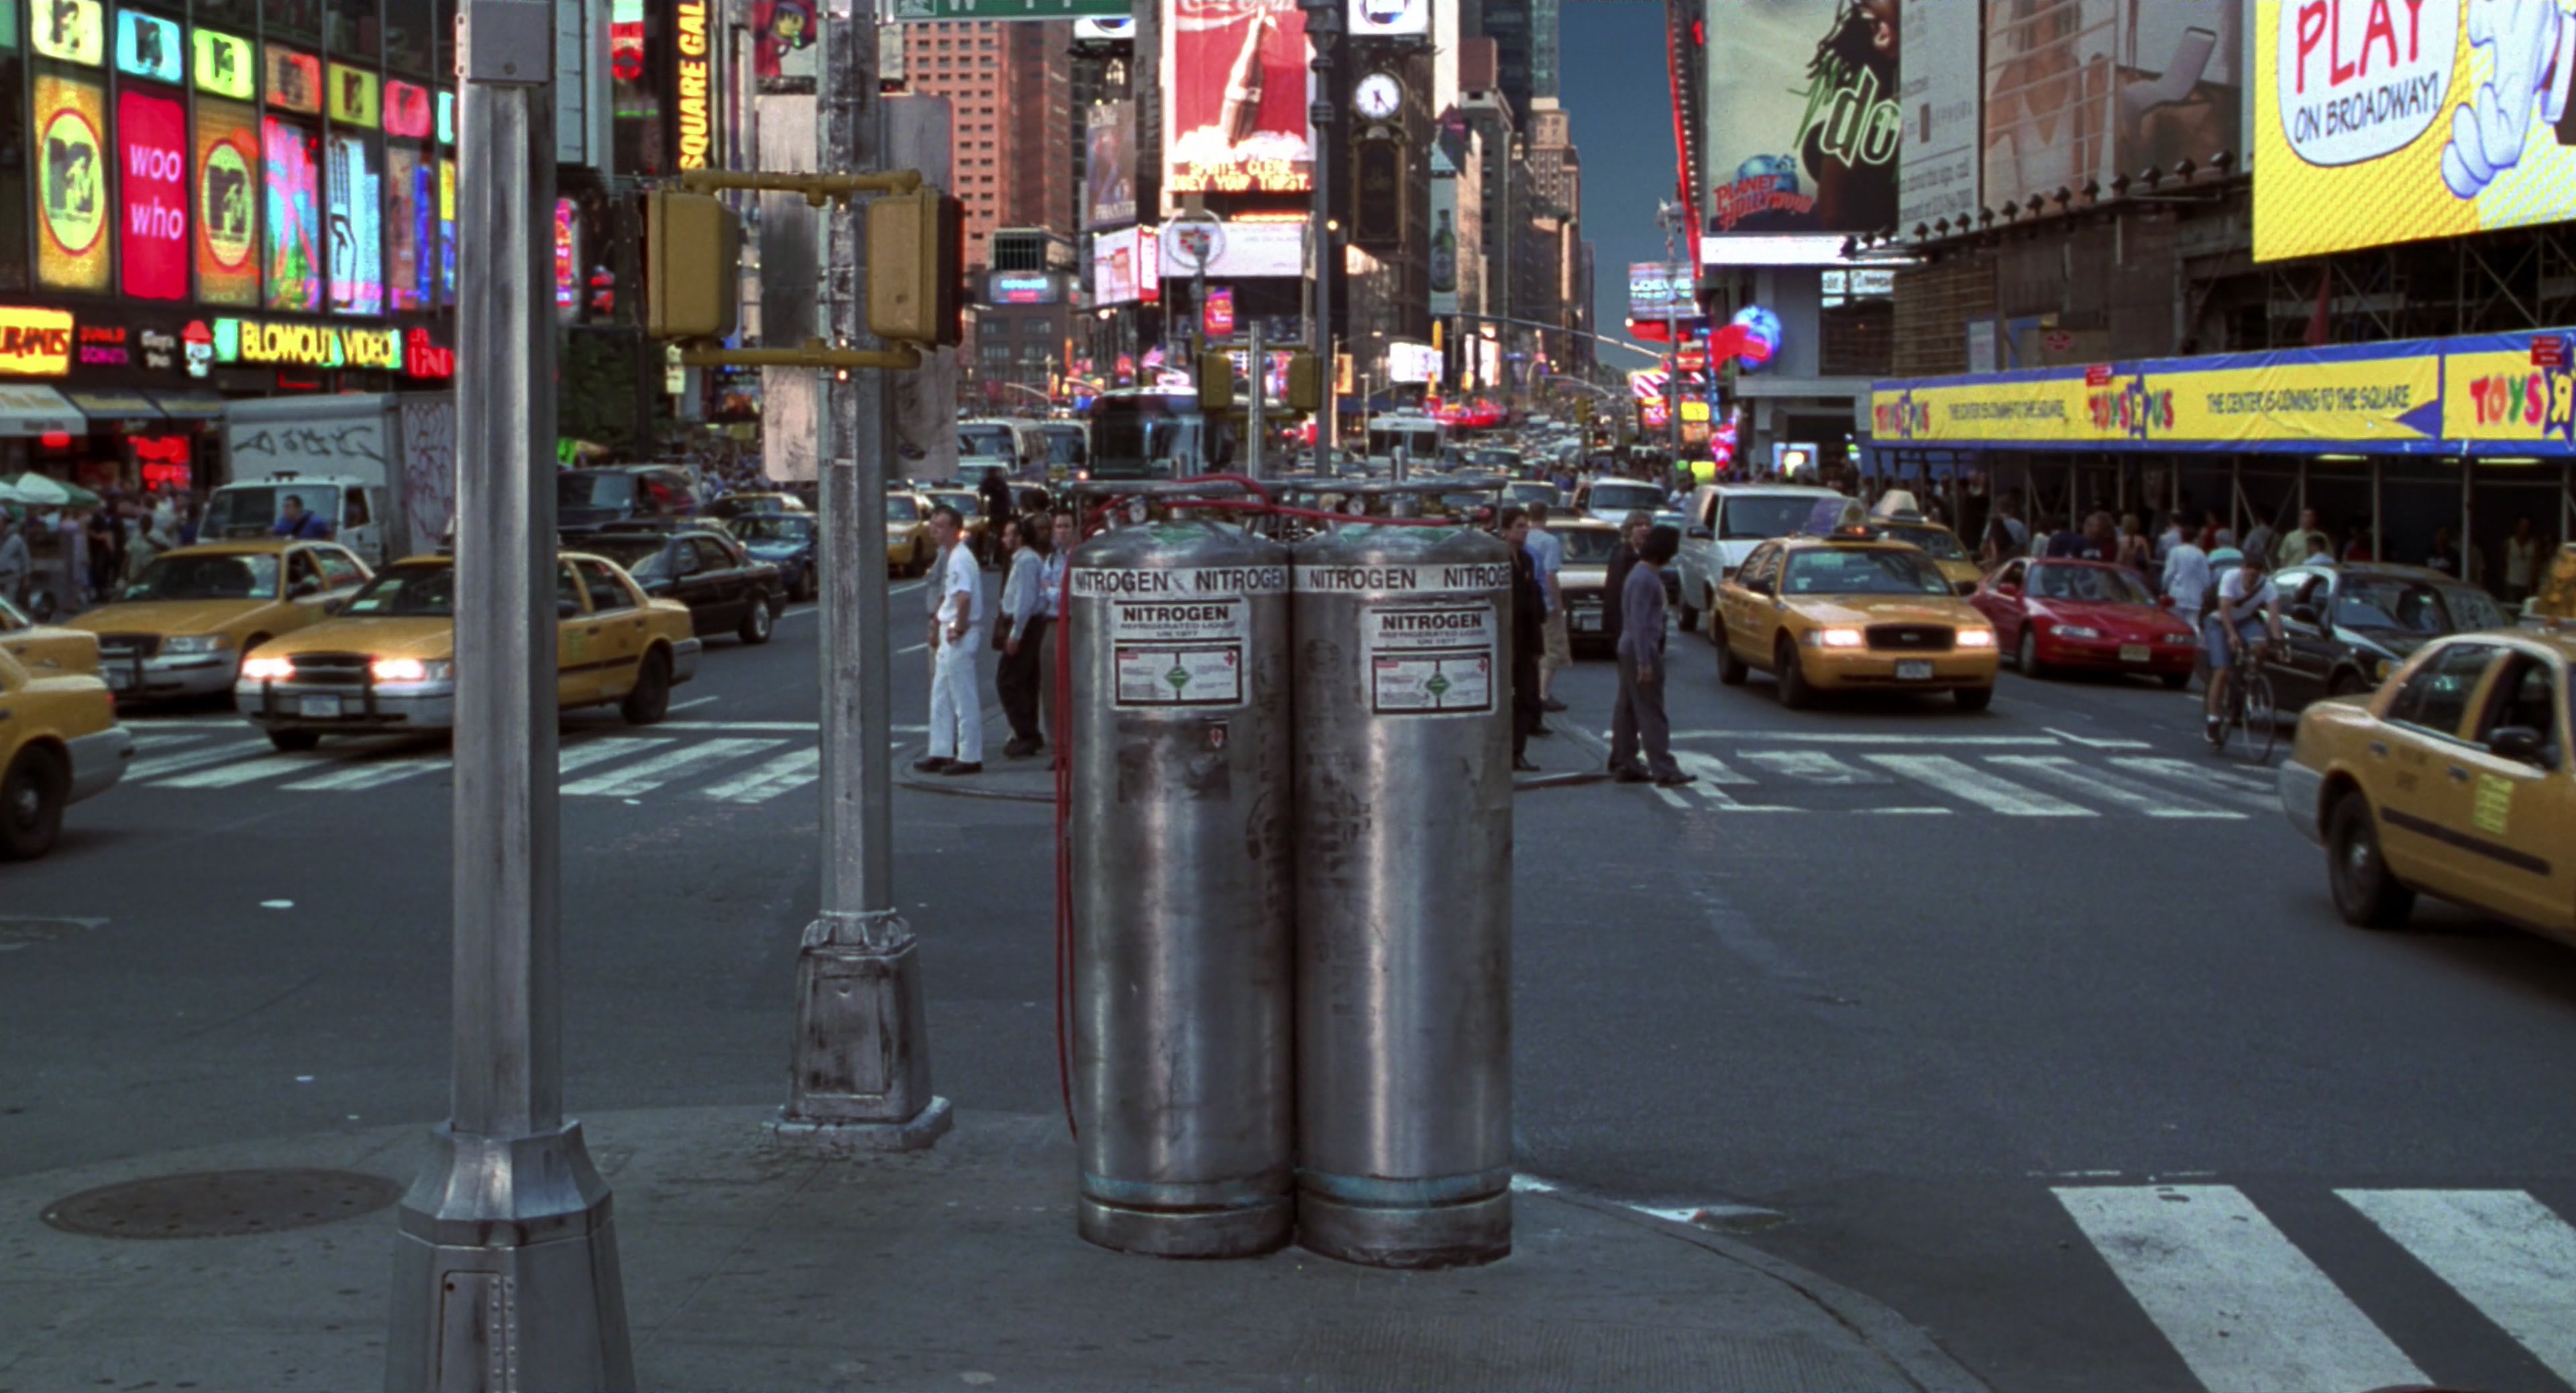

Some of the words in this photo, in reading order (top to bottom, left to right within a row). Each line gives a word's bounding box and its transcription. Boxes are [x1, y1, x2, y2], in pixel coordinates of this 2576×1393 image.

[2296, 0, 2424, 94] PLAY
[679, 60, 708, 170] SQUARE
[2294, 103, 2320, 144] ON
[129, 144, 181, 183] woo
[1714, 174, 1782, 215] PLANET
[1719, 191, 1814, 232] HOLLYWOOD
[131, 196, 184, 240] who
[241, 321, 333, 364] BLOWOUT
[341, 328, 393, 365] VIDEO
[2088, 390, 2129, 431] TOYS
[2151, 389, 2174, 431] US
[2470, 372, 2544, 426] TOYS
[1309, 568, 1416, 590] NITROGEN
[1122, 606, 1229, 622] NITROGEN
[1382, 613, 1482, 630] NITROGEN
